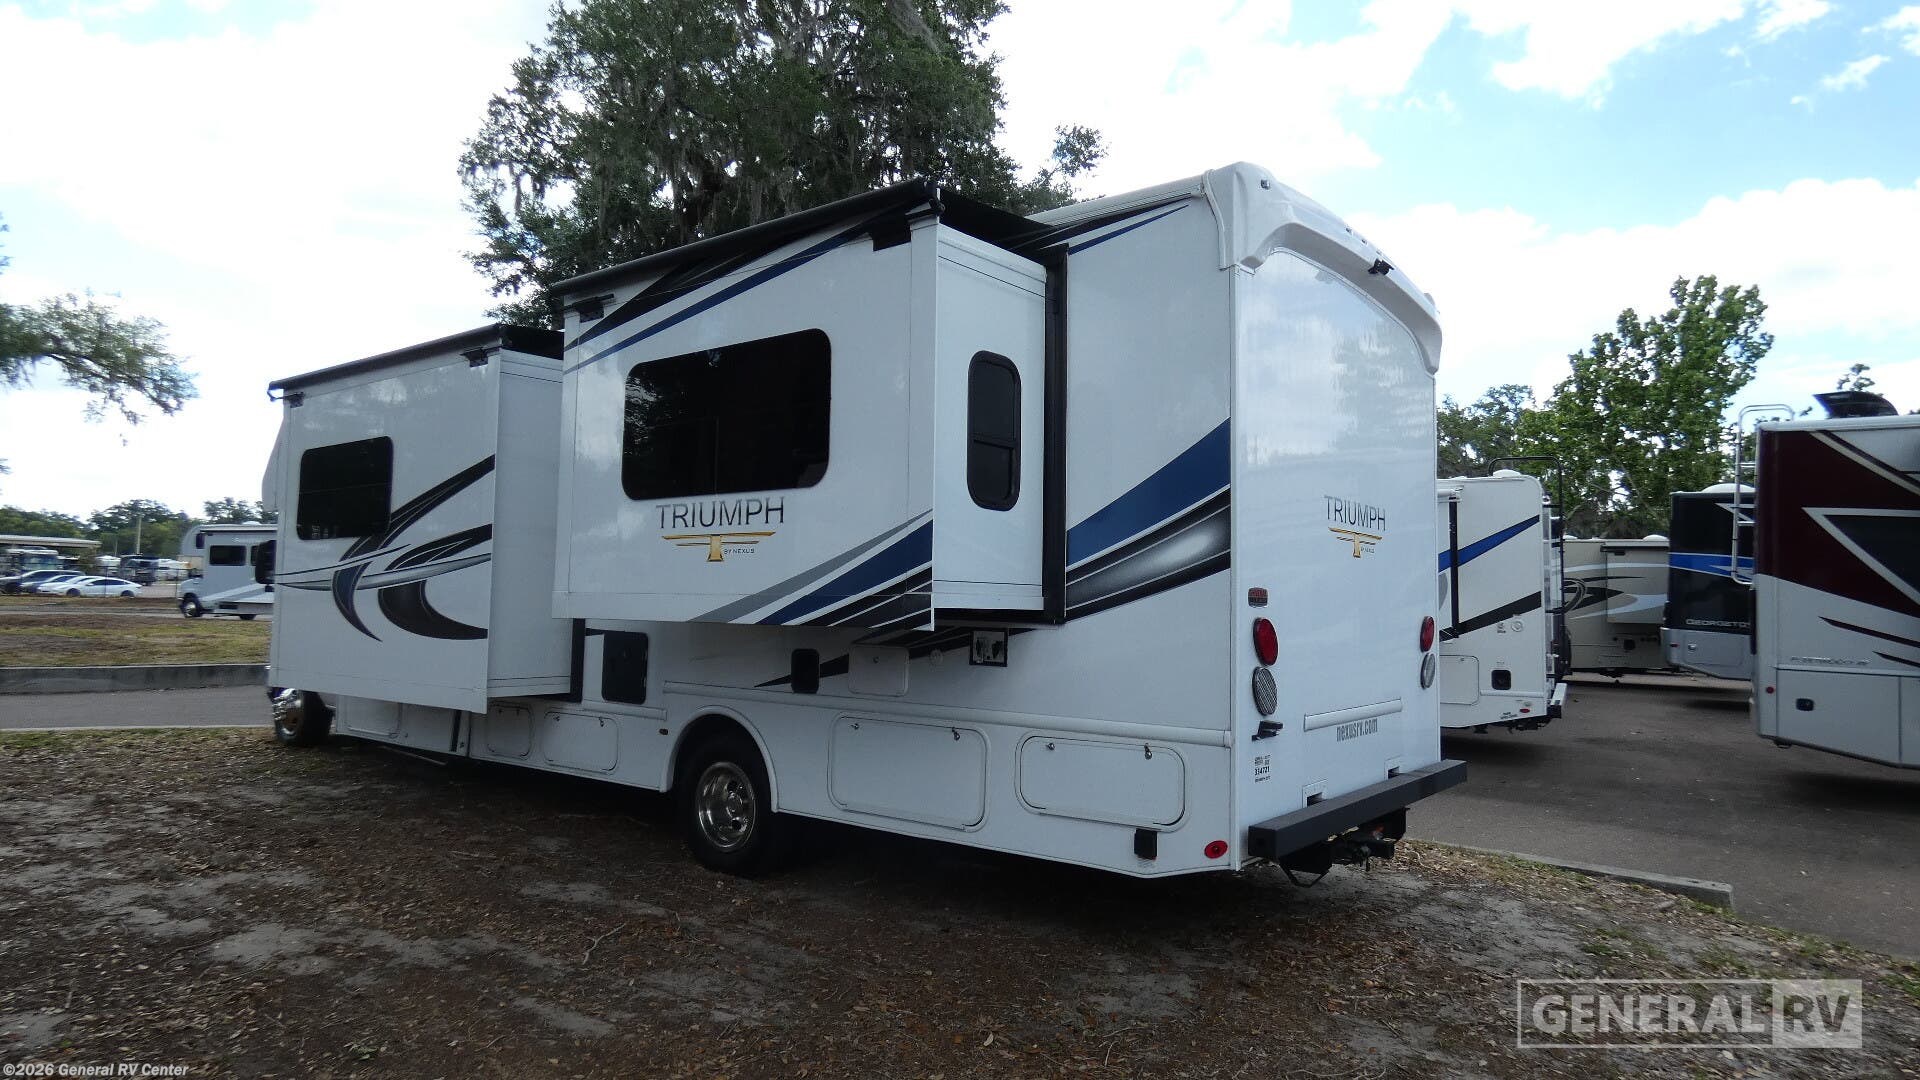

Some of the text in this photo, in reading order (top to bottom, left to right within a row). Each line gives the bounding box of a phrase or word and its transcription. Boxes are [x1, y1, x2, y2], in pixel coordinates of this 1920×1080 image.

[656, 496, 785, 529] TRIUMPH
[1324, 495, 1386, 531] TRIUMPH
[1686, 619, 1751, 628] GEORGETO
[1336, 718, 1378, 742] nexusrv.com
